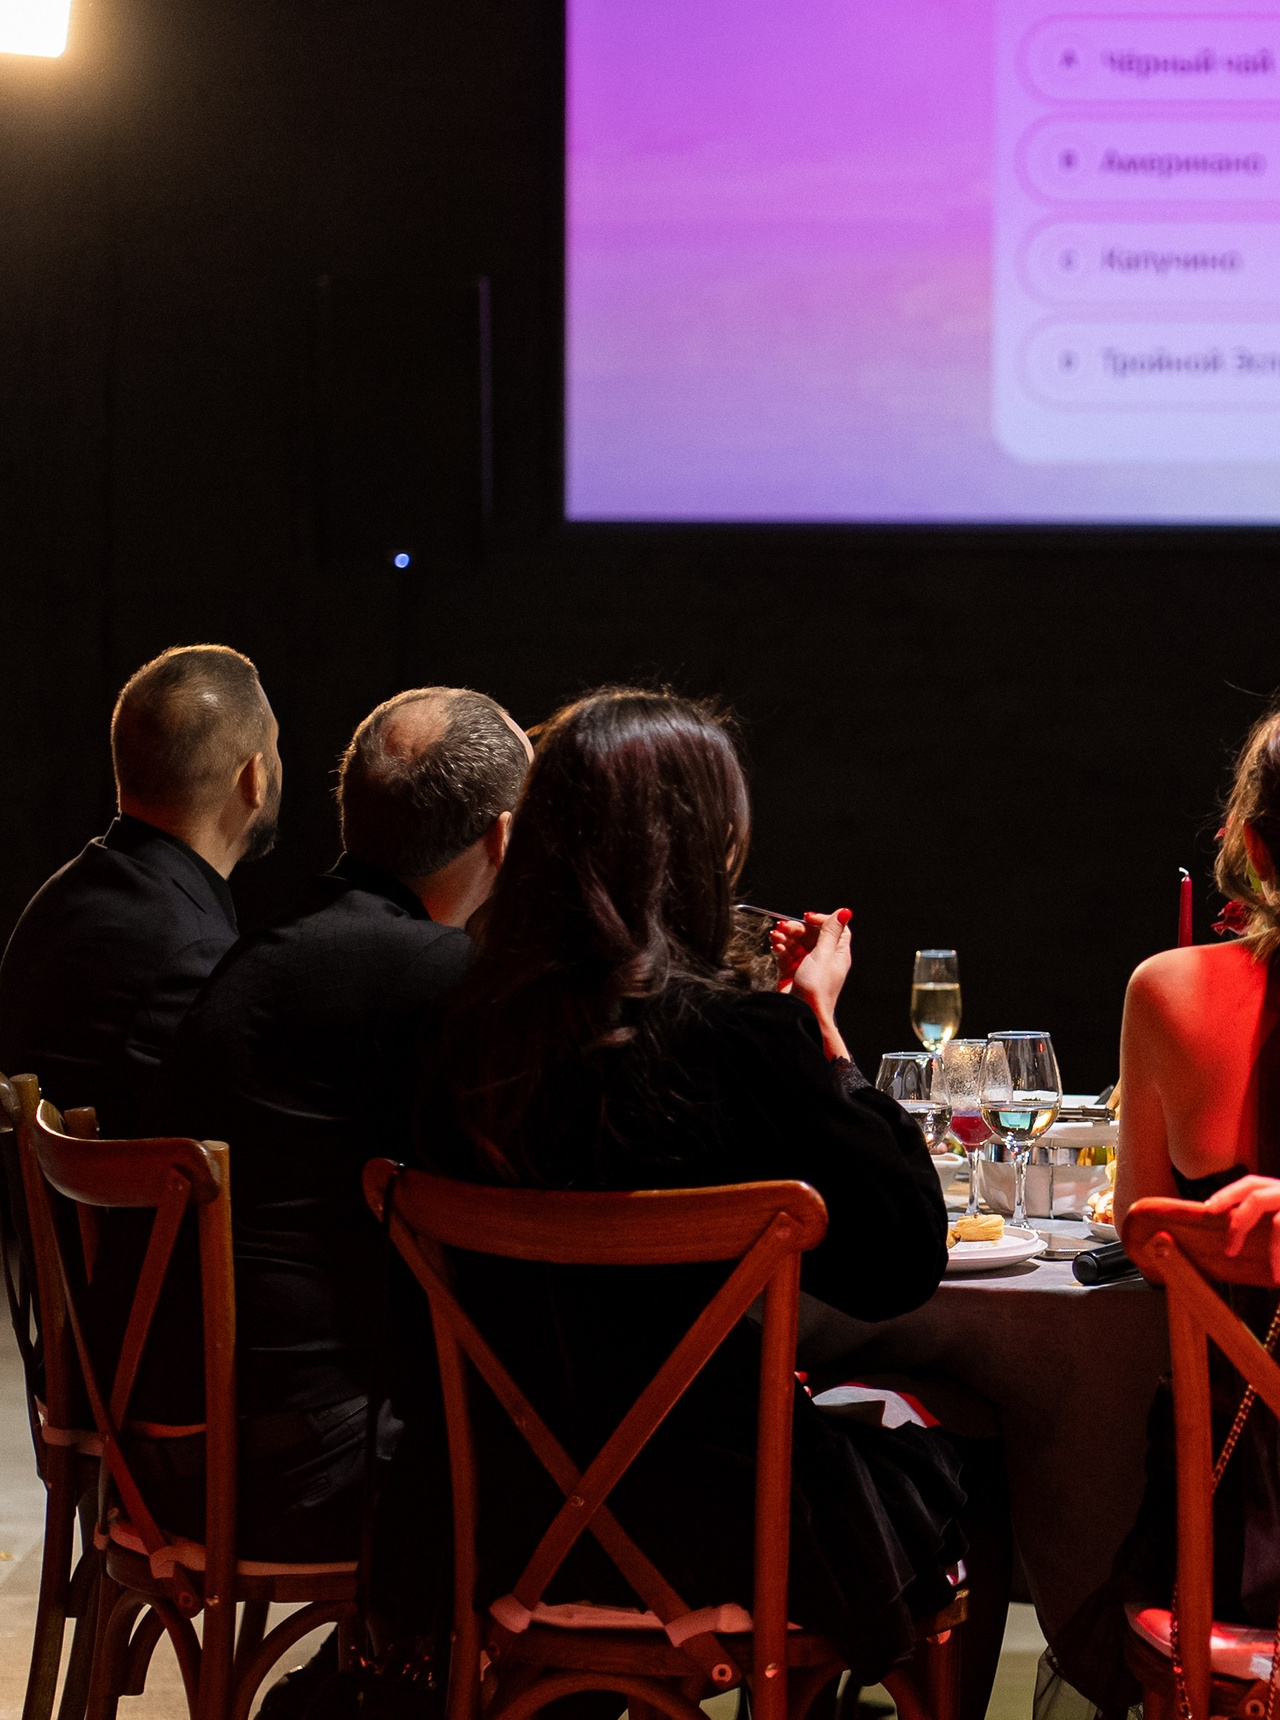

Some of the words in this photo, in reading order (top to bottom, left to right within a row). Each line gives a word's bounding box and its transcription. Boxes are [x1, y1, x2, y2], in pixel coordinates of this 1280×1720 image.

[1221, 48, 1275, 76] чай
[1100, 149, 1266, 178] Американо
[1102, 247, 1242, 276] Капучино
